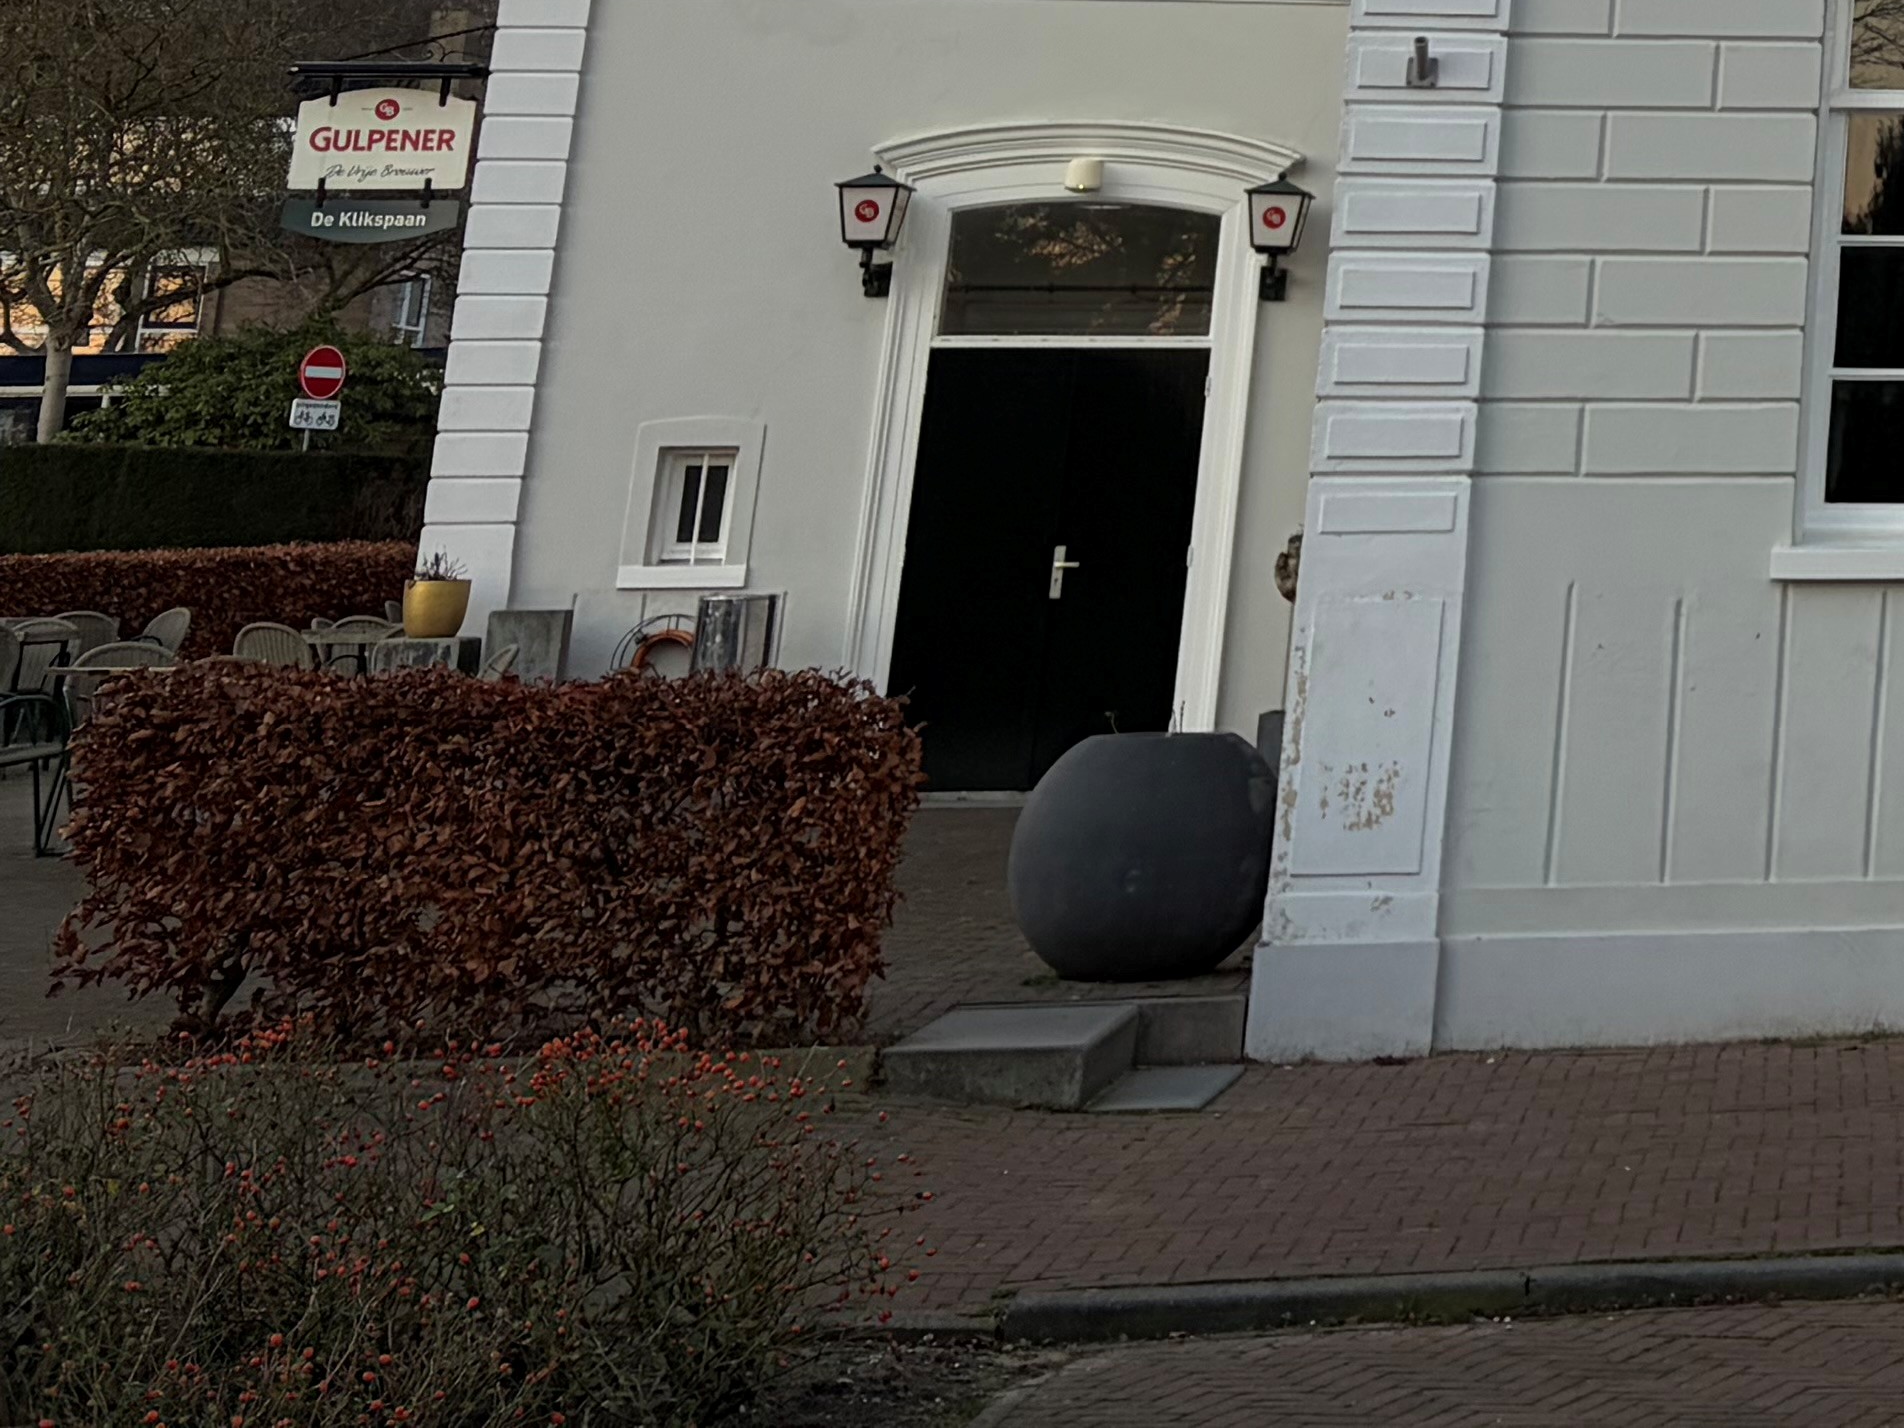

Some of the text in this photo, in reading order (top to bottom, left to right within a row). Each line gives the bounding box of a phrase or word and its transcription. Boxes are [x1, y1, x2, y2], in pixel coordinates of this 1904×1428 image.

[309, 126, 456, 153] GULPENER
[311, 211, 426, 230] De Klikspaan
